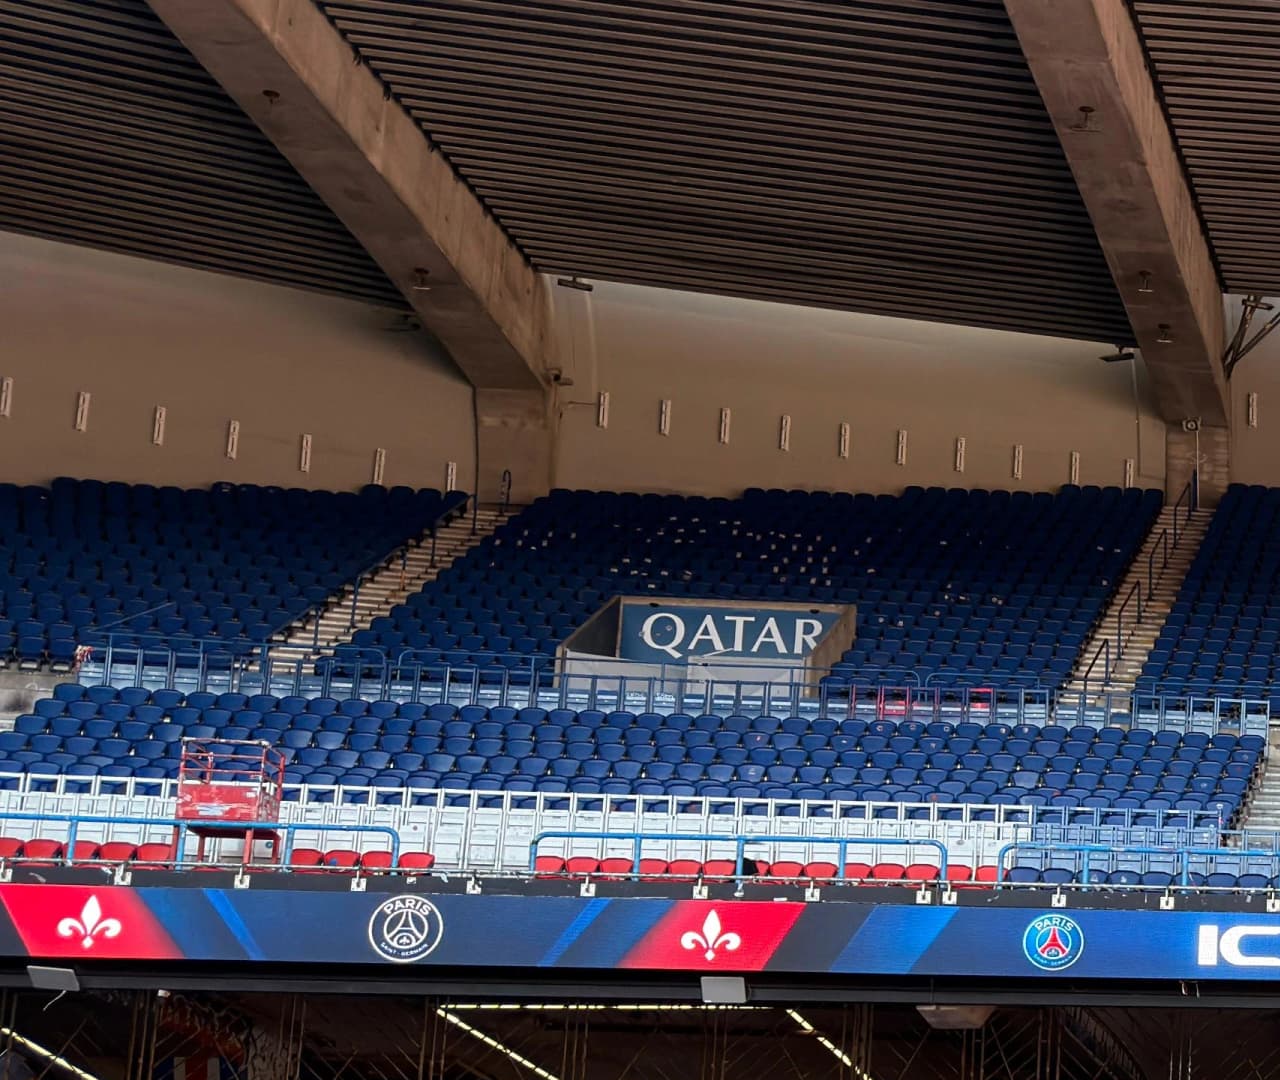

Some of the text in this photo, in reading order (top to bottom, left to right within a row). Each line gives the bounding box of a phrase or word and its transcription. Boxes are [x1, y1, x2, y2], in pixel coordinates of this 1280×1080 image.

[641, 612, 824, 659] QATAR
[383, 899, 431, 915] PARIS
[1035, 917, 1074, 931] PARIS
